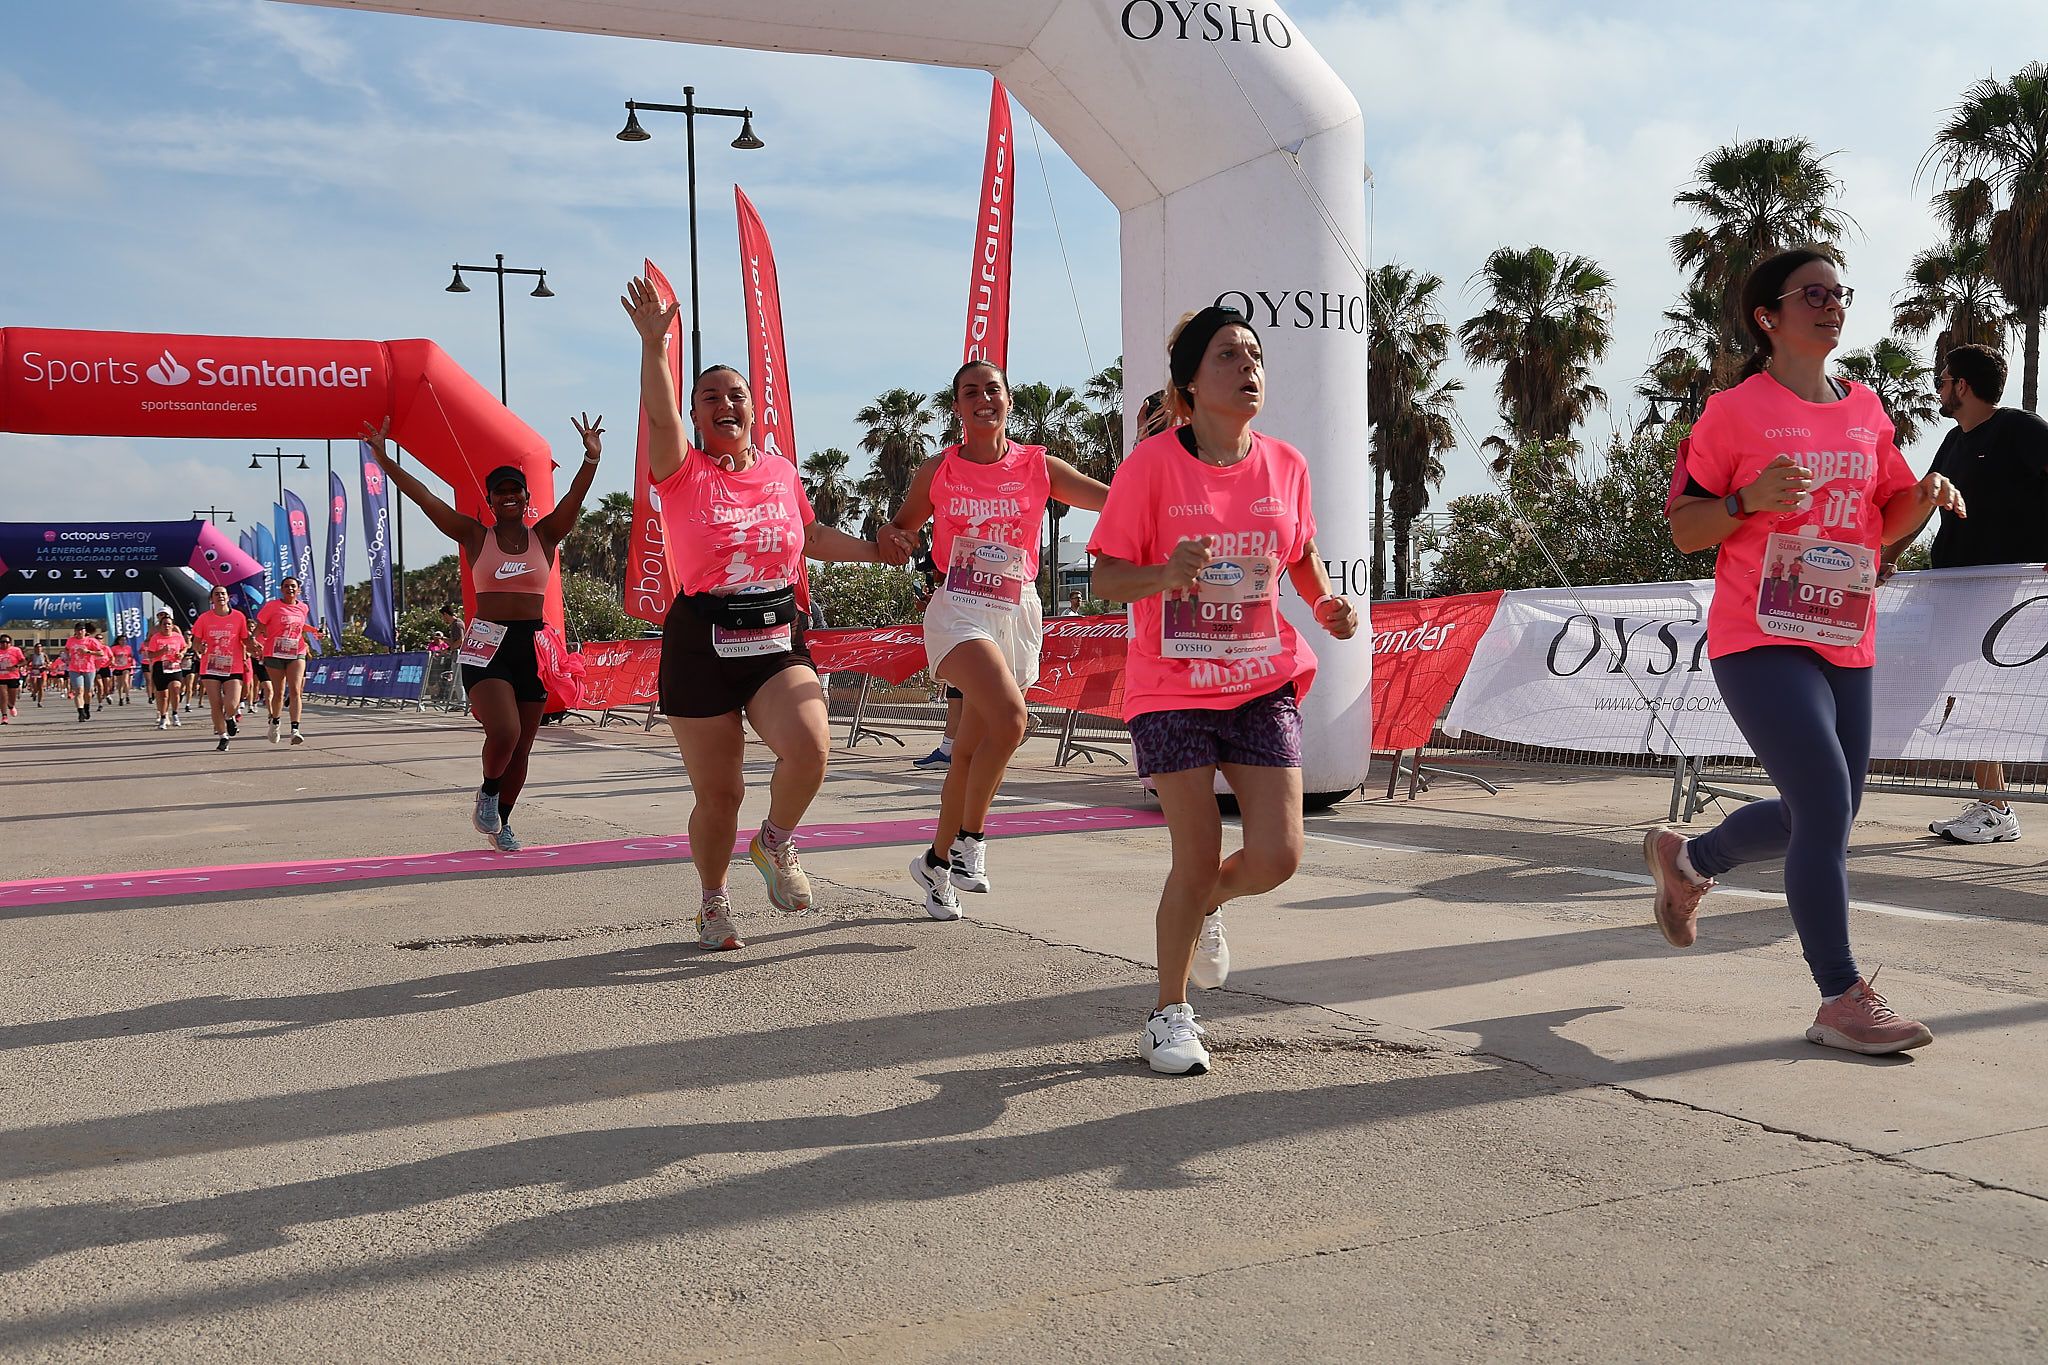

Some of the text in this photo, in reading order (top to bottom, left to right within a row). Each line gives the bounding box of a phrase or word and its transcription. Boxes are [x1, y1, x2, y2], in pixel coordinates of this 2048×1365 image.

[1121, 0, 1292, 49] OYSHO
[1213, 290, 1364, 335] OYSHO
[23, 352, 372, 390] Sports Santander
[141, 400, 257, 412] sportssantander.es
[1765, 427, 1812, 439] OYSHO
[949, 497, 1022, 517] CARRERA
[1168, 503, 1215, 517] OYSHO
[1823, 490, 1861, 529] DE
[60, 531, 151, 543] octopus energy
[757, 526, 783, 553] DE
[1177, 530, 1278, 557] RRERA
[51, 546, 91, 554] ENERGÍA
[120, 546, 156, 554] CORRER
[501, 561, 526, 572] NIKE
[1805, 552, 1851, 568] ASTURIANA
[18, 568, 139, 579] VOLVO
[973, 571, 1003, 587] 016
[952, 595, 977, 605] OYSHO
[1800, 584, 1844, 606] 016
[33, 597, 82, 615] Marlene
[1201, 602, 1243, 621] 016
[1808, 605, 1829, 616] 2110
[1768, 608, 1795, 619] CARRERA
[1796, 612, 1804, 620] DE
[1813, 615, 1832, 625] MUJER
[1212, 624, 1234, 632] 3205
[1767, 620, 1805, 634] OYSHO
[1174, 631, 1200, 639] CARRERA
[1209, 632, 1218, 640] LA
[1372, 621, 1456, 655] ander
[467, 638, 485, 650] 016
[1175, 643, 1212, 653] OYSHO
[1233, 644, 1268, 654] Santander
[1546, 614, 1708, 677] OYS
